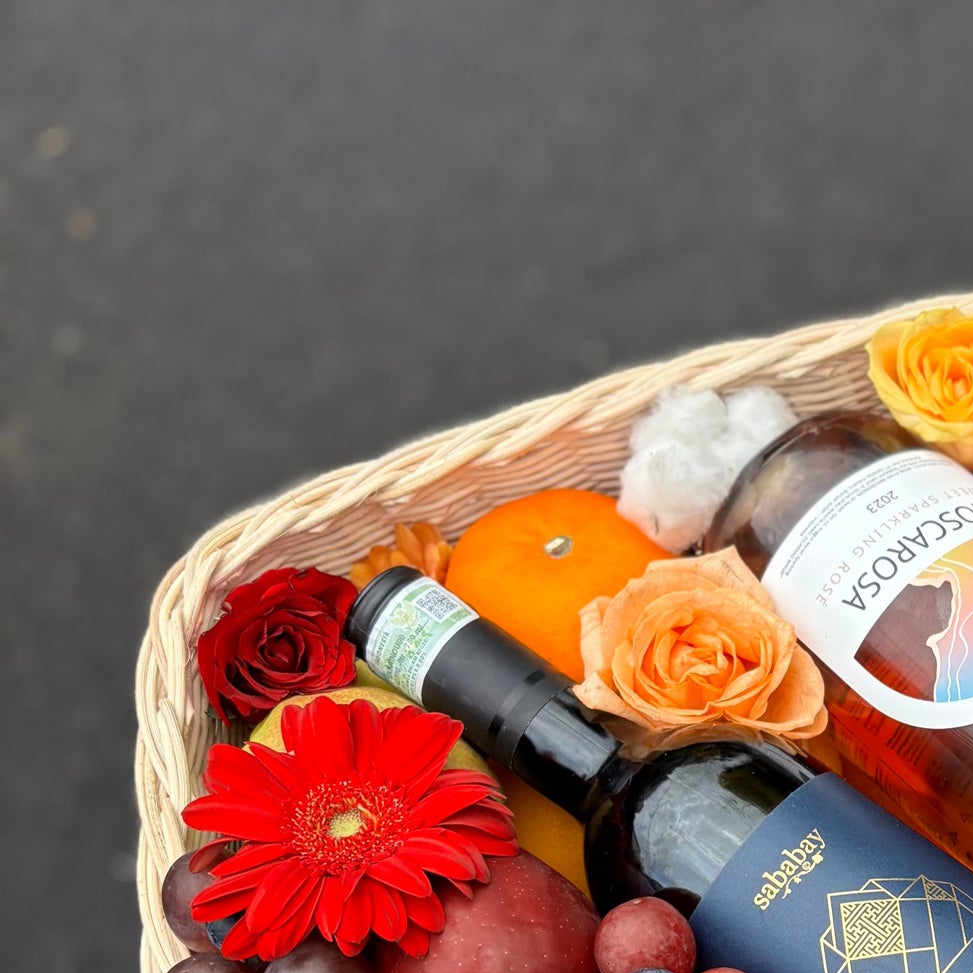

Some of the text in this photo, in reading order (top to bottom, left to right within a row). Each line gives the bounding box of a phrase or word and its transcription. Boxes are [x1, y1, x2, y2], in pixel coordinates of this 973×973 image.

[852, 494, 940, 558] SPARKLING
[866, 490, 899, 514] 2023
[753, 828, 825, 910] sababay
